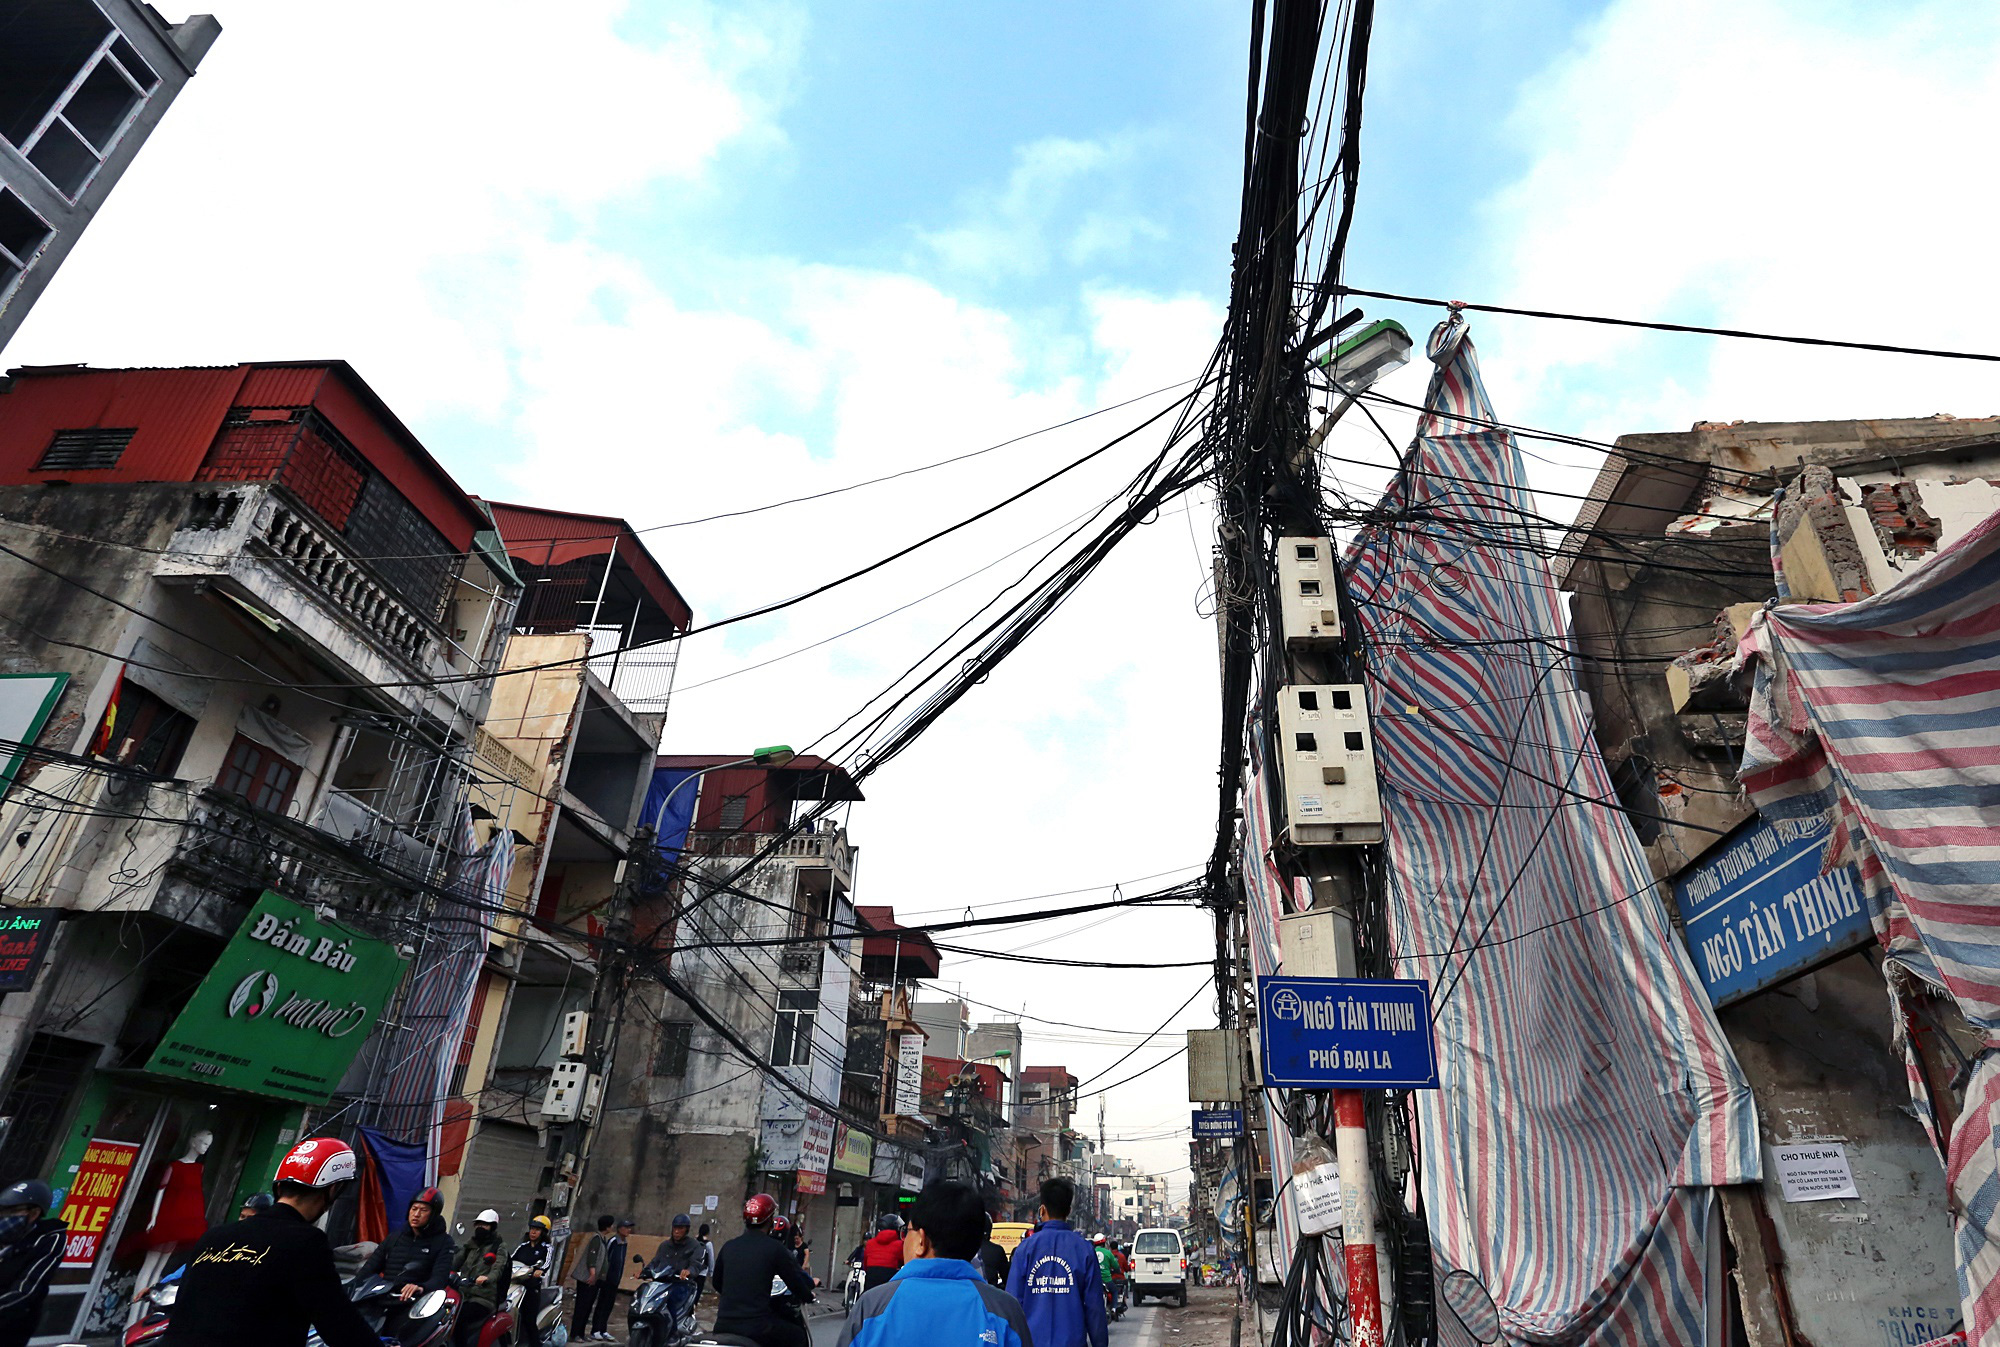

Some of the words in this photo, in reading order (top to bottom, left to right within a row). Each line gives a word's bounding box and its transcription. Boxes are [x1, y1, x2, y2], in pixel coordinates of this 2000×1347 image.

[1686, 866, 1721, 907] PHƯỜNG
[1750, 826, 1779, 865] ĐỊNH
[1702, 914, 1742, 984] NGÕ
[1739, 901, 1786, 965] TÂN
[1783, 865, 1861, 943] THỊNH
[249, 912, 311, 957] Đầm
[309, 938, 358, 973] Bầu
[1303, 996, 1335, 1031] NGÕ
[1338, 996, 1369, 1031] TÂN
[1371, 1002, 1416, 1036] THỊNH
[1309, 1043, 1340, 1069] PHỐ
[1344, 1050, 1369, 1072] ĐẠI
[1374, 1050, 1392, 1070] LA
[98, 1147, 116, 1165] CUỐI
[115, 1150, 133, 1167] NĂM
[1781, 1153, 1799, 1162] CHO
[1800, 1150, 1821, 1160] THUÊ
[76, 1172, 90, 1196] 2
[86, 1169, 116, 1202] TẶNG
[113, 1175, 124, 1198] 1
[1035, 1275, 1049, 1287] VIỆT
